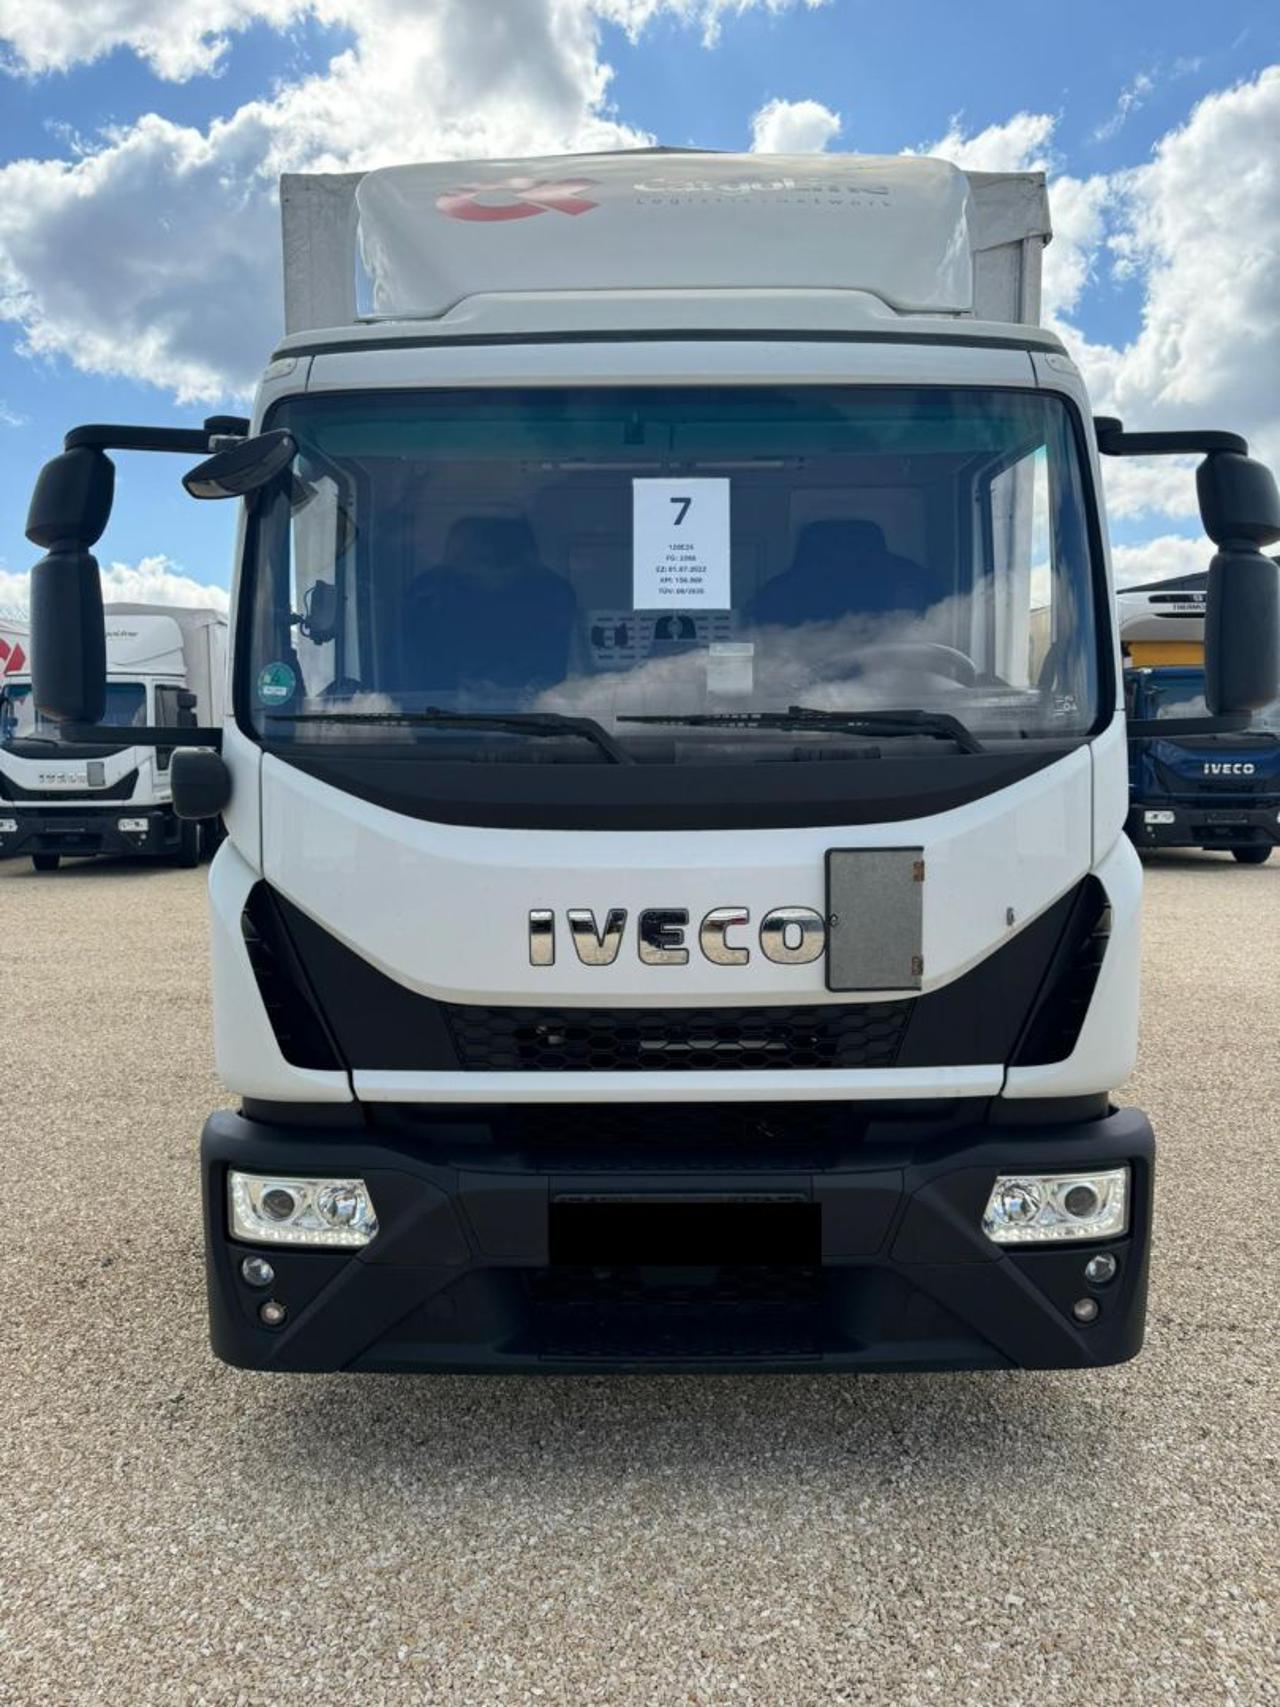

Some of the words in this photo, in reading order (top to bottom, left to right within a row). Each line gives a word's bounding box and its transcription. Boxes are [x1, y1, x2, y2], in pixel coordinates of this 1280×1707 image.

[670, 497, 691, 525] 7
[1203, 763, 1255, 774] IVECO
[528, 906, 827, 966] IVECO
